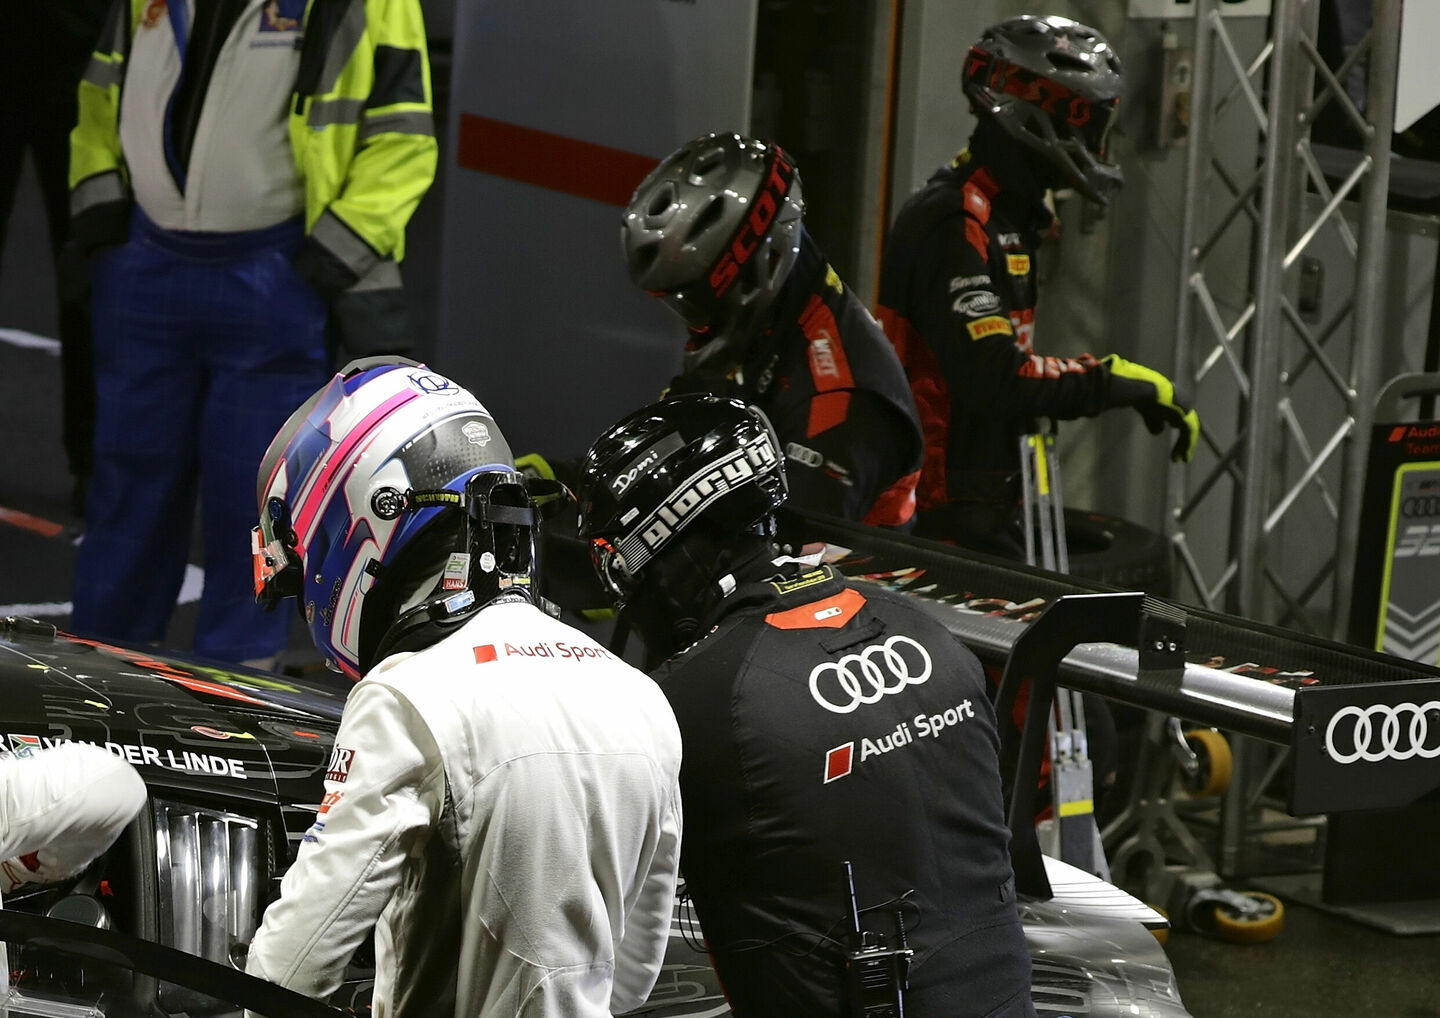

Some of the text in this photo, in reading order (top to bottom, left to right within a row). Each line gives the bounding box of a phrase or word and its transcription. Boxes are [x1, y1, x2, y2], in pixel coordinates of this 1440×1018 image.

[710, 147, 791, 298] SCOT
[613, 451, 659, 495] Domi
[504, 642, 612, 662] Audi Sport
[860, 699, 975, 763] Audi Sport
[105, 742, 163, 767] DER
[167, 749, 248, 780] LINDE
